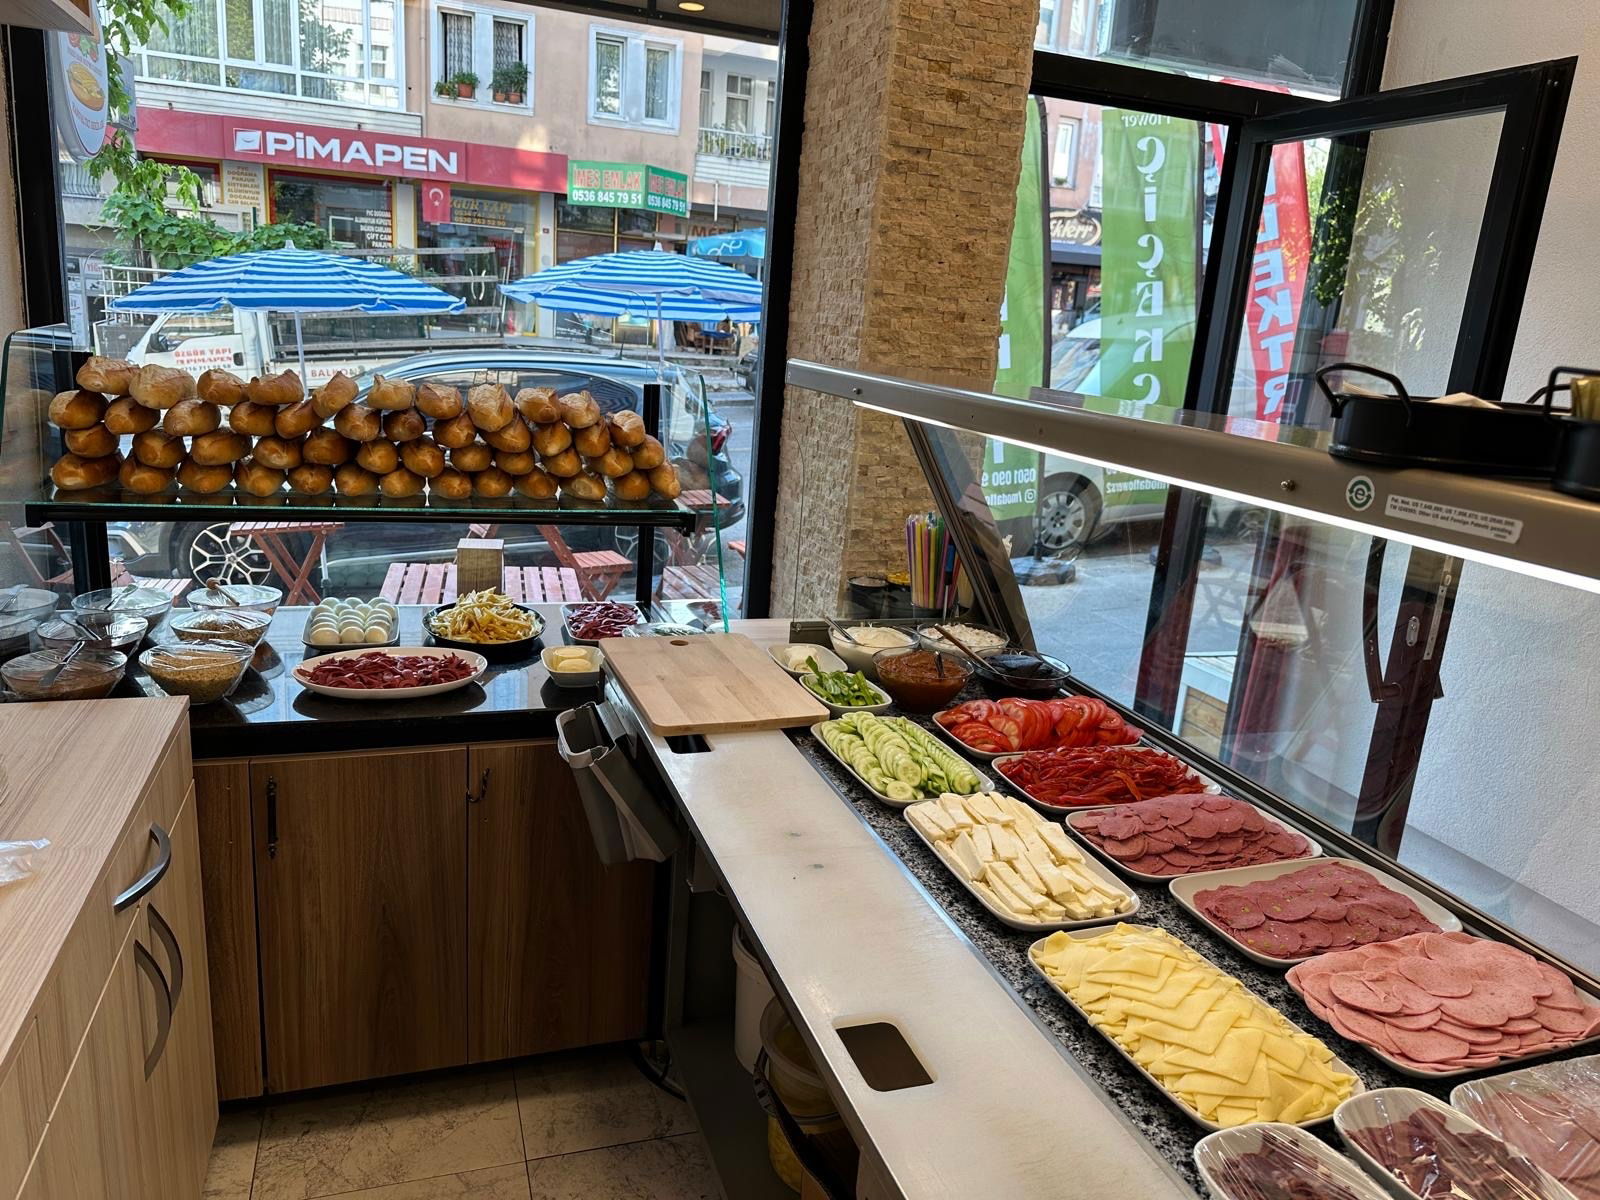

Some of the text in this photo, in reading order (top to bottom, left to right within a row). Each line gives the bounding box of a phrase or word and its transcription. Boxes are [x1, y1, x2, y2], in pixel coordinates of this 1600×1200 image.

[572, 189, 642, 205] 0536 845 79 51
